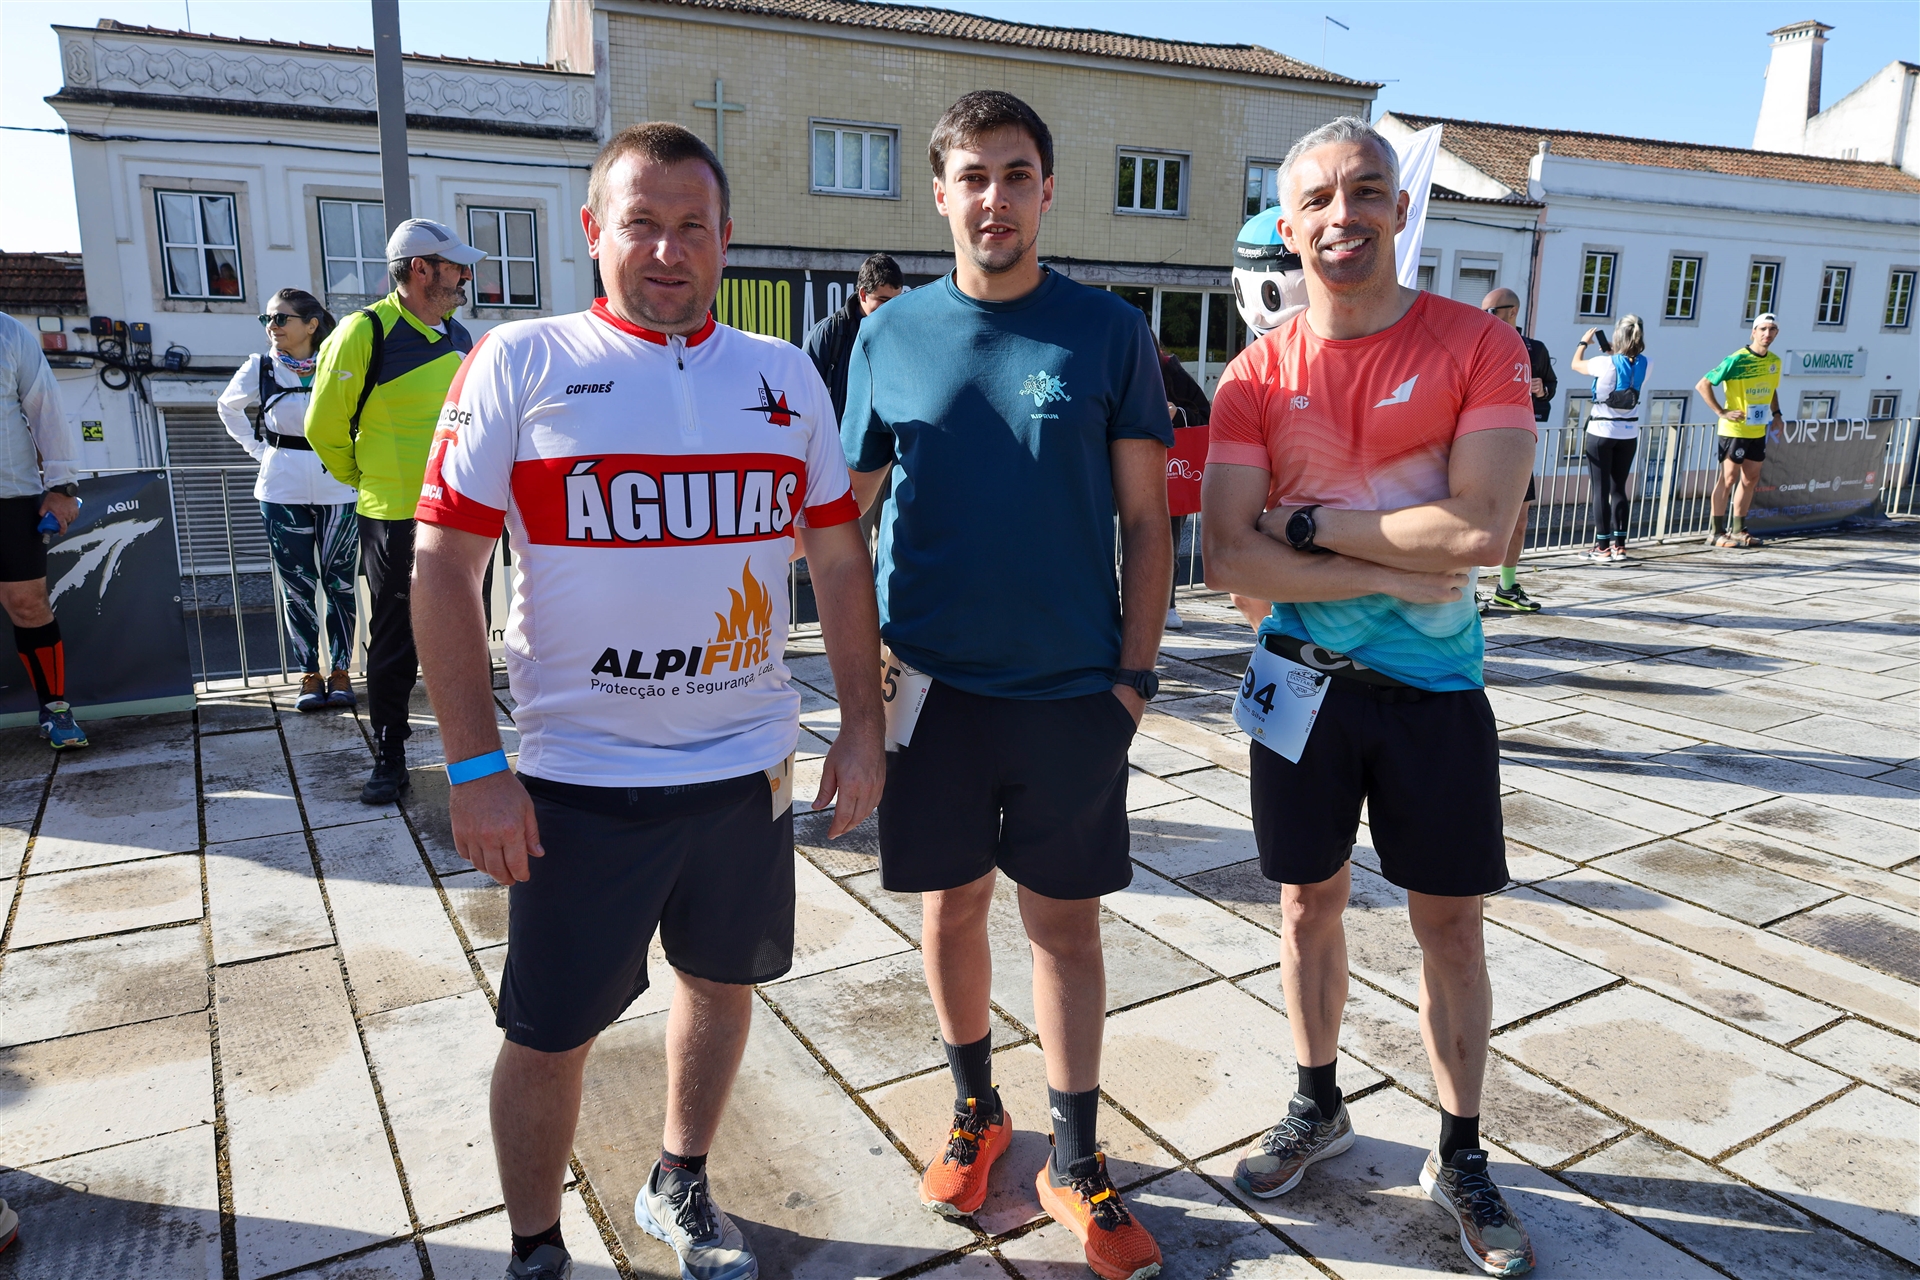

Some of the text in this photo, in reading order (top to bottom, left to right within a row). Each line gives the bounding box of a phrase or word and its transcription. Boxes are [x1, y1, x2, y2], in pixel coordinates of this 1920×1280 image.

[1803, 354, 1854, 368] O MIRANTE
[1755, 410, 1764, 419] 81
[107, 500, 139, 514] AQUI
[564, 458, 798, 542] ÁGUIAS
[591, 679, 666, 699] Protecção
[671, 686, 680, 696] e
[881, 659, 901, 702] 5
[1241, 665, 1277, 715] 94
[1250, 709, 1266, 723] Silva
